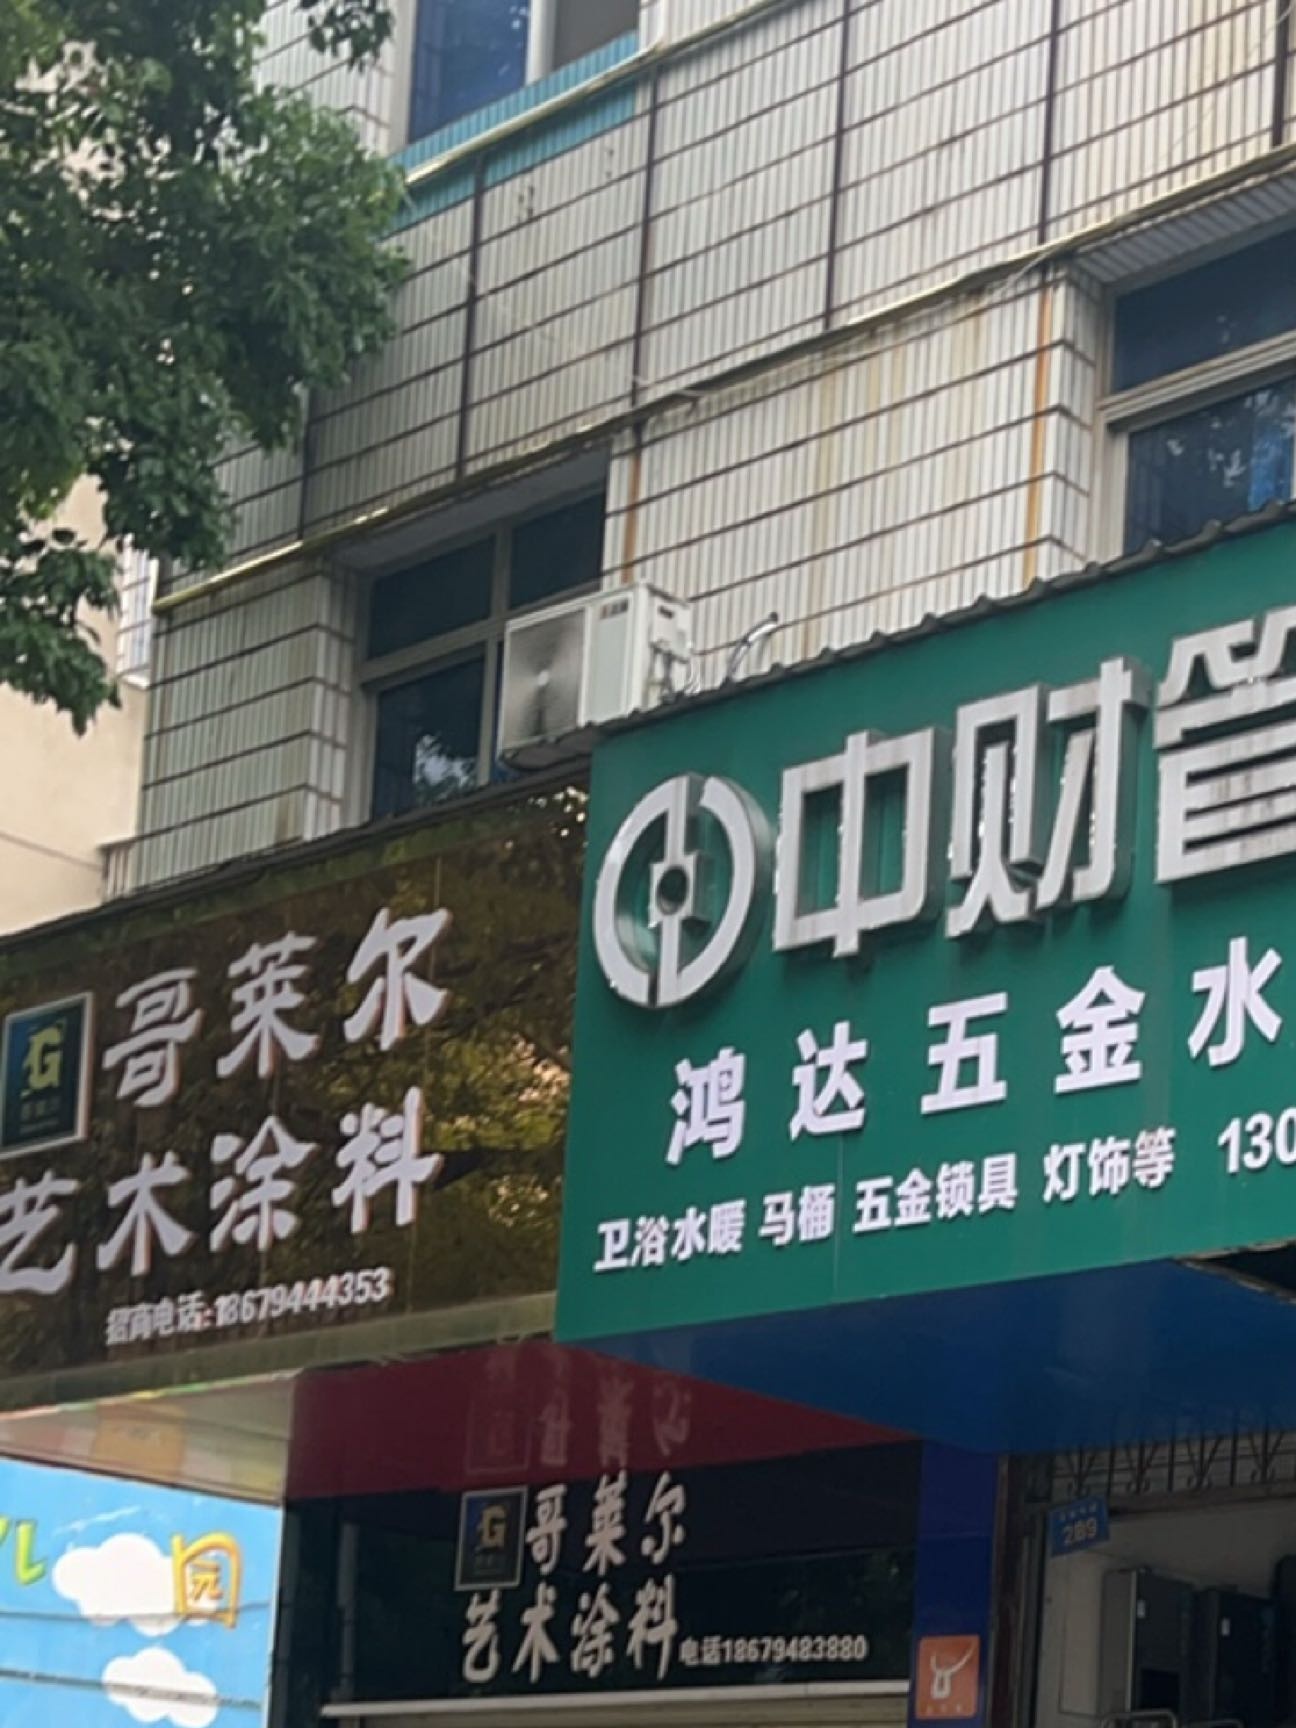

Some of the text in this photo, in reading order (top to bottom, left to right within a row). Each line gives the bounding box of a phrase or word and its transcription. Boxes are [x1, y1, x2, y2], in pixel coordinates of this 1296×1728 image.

[102, 906, 453, 1108] 哥莱尔
[0, 1086, 443, 1297] 艺术涂料
[593, 1200, 746, 1273] 卫浴水暖
[757, 1185, 836, 1247] 马桶
[852, 1153, 1018, 1234] 五金锁具
[1042, 1127, 1177, 1204] 灯饰等
[525, 1468, 686, 1577] 哥莱尔
[461, 1573, 680, 1685] 艺术涂料
